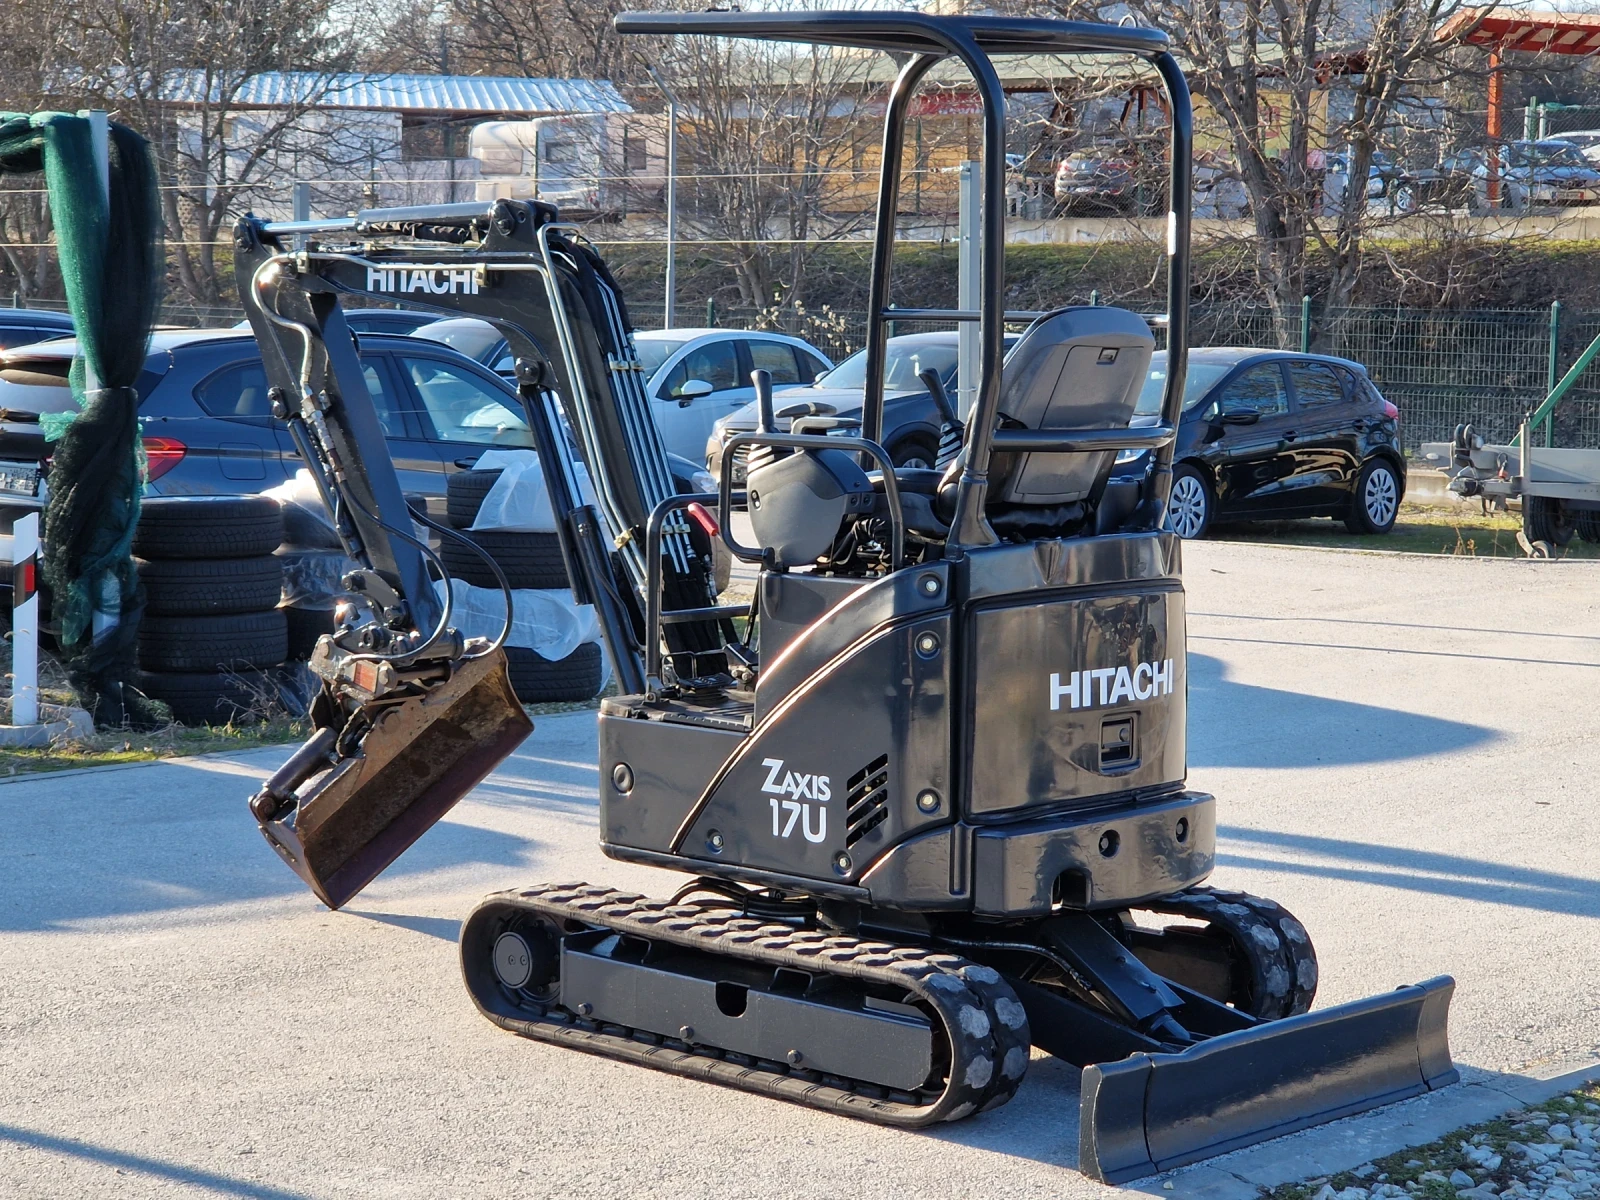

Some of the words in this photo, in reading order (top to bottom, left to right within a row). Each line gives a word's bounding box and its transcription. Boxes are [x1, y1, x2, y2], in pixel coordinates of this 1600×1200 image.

[367, 262, 480, 295] HITACHI
[1049, 658, 1174, 711] HITACHI
[761, 757, 832, 801] ZAXIS
[769, 798, 827, 843] 17U
